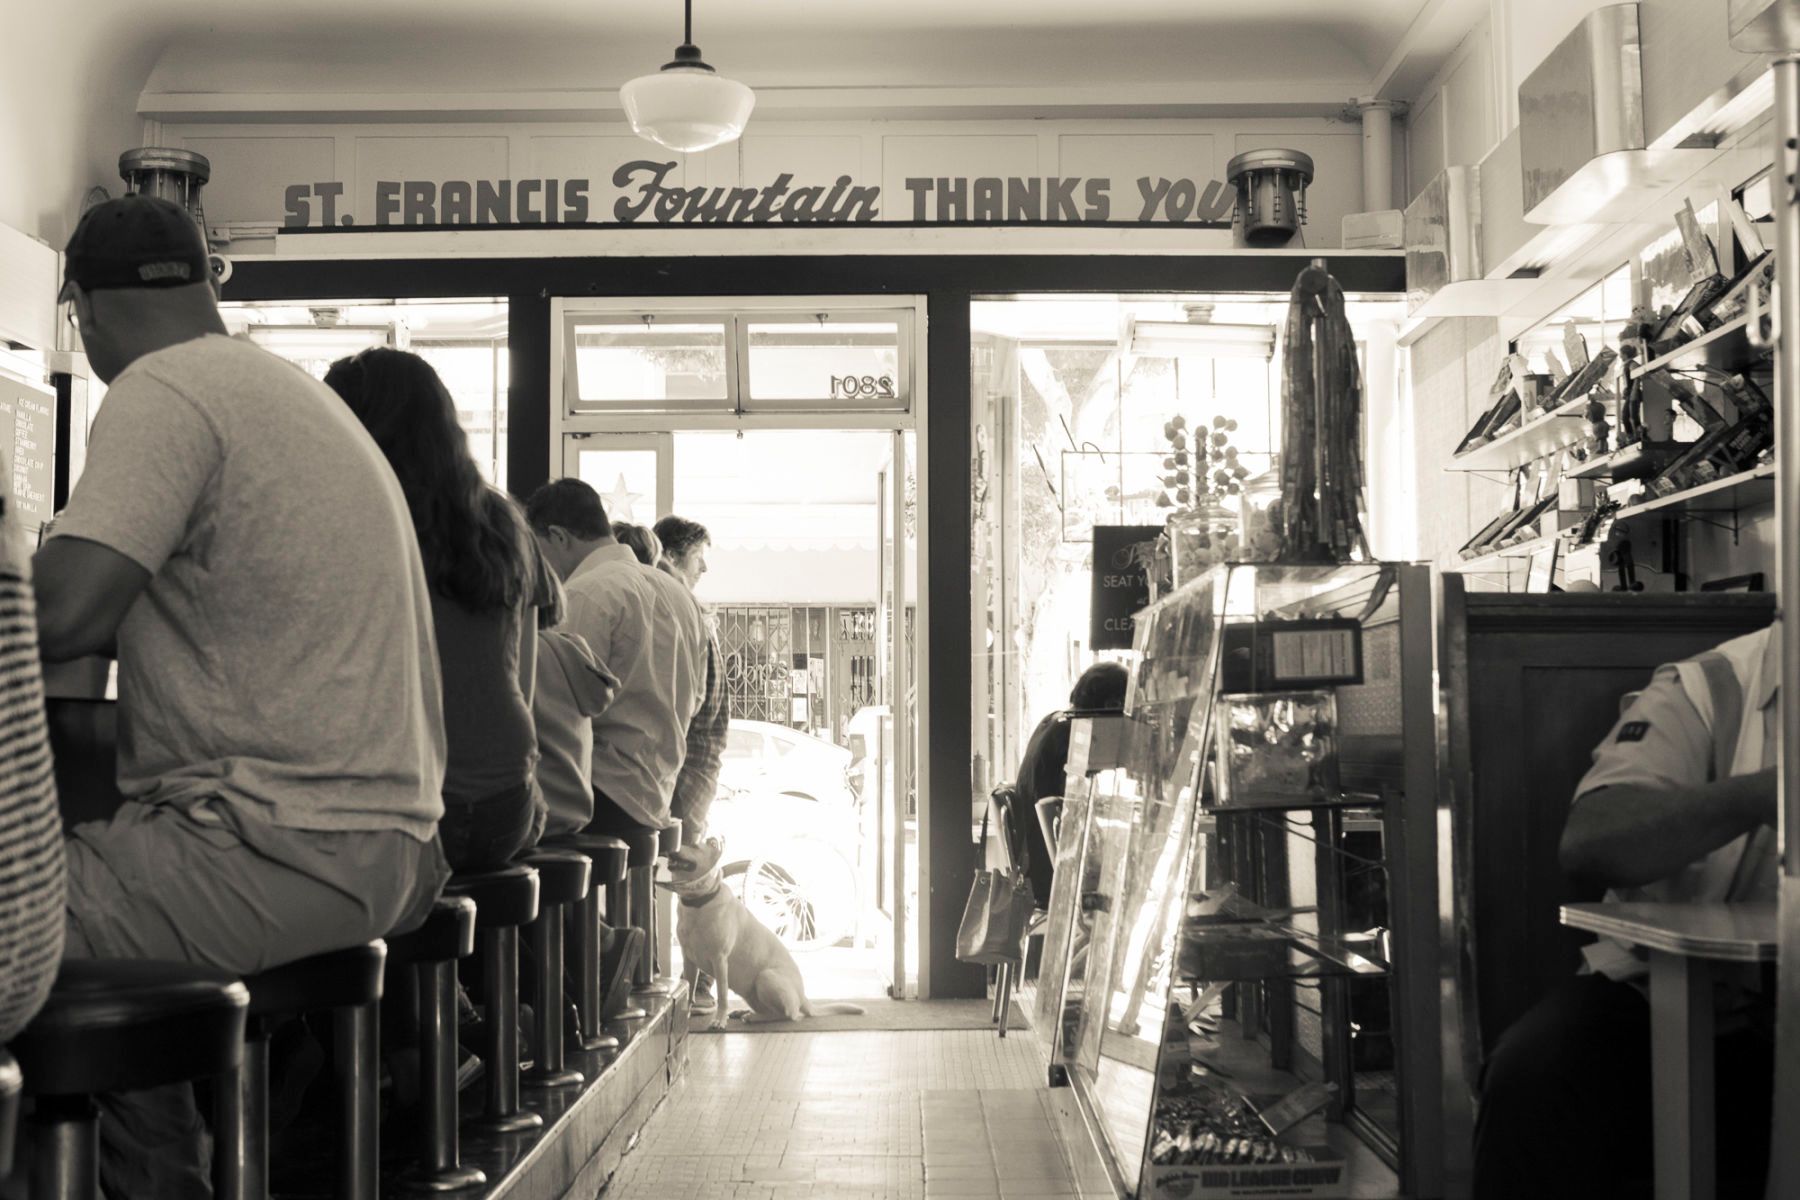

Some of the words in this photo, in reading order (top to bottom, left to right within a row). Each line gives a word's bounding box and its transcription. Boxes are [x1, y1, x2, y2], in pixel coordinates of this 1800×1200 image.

[285, 182, 354, 227] ST.
[376, 179, 590, 225] FRANCIS
[612, 160, 881, 223] Fountain
[905, 177, 1111, 222] THANKS
[1136, 176, 1238, 223] YOU
[1103, 575, 1133, 588] SEAT
